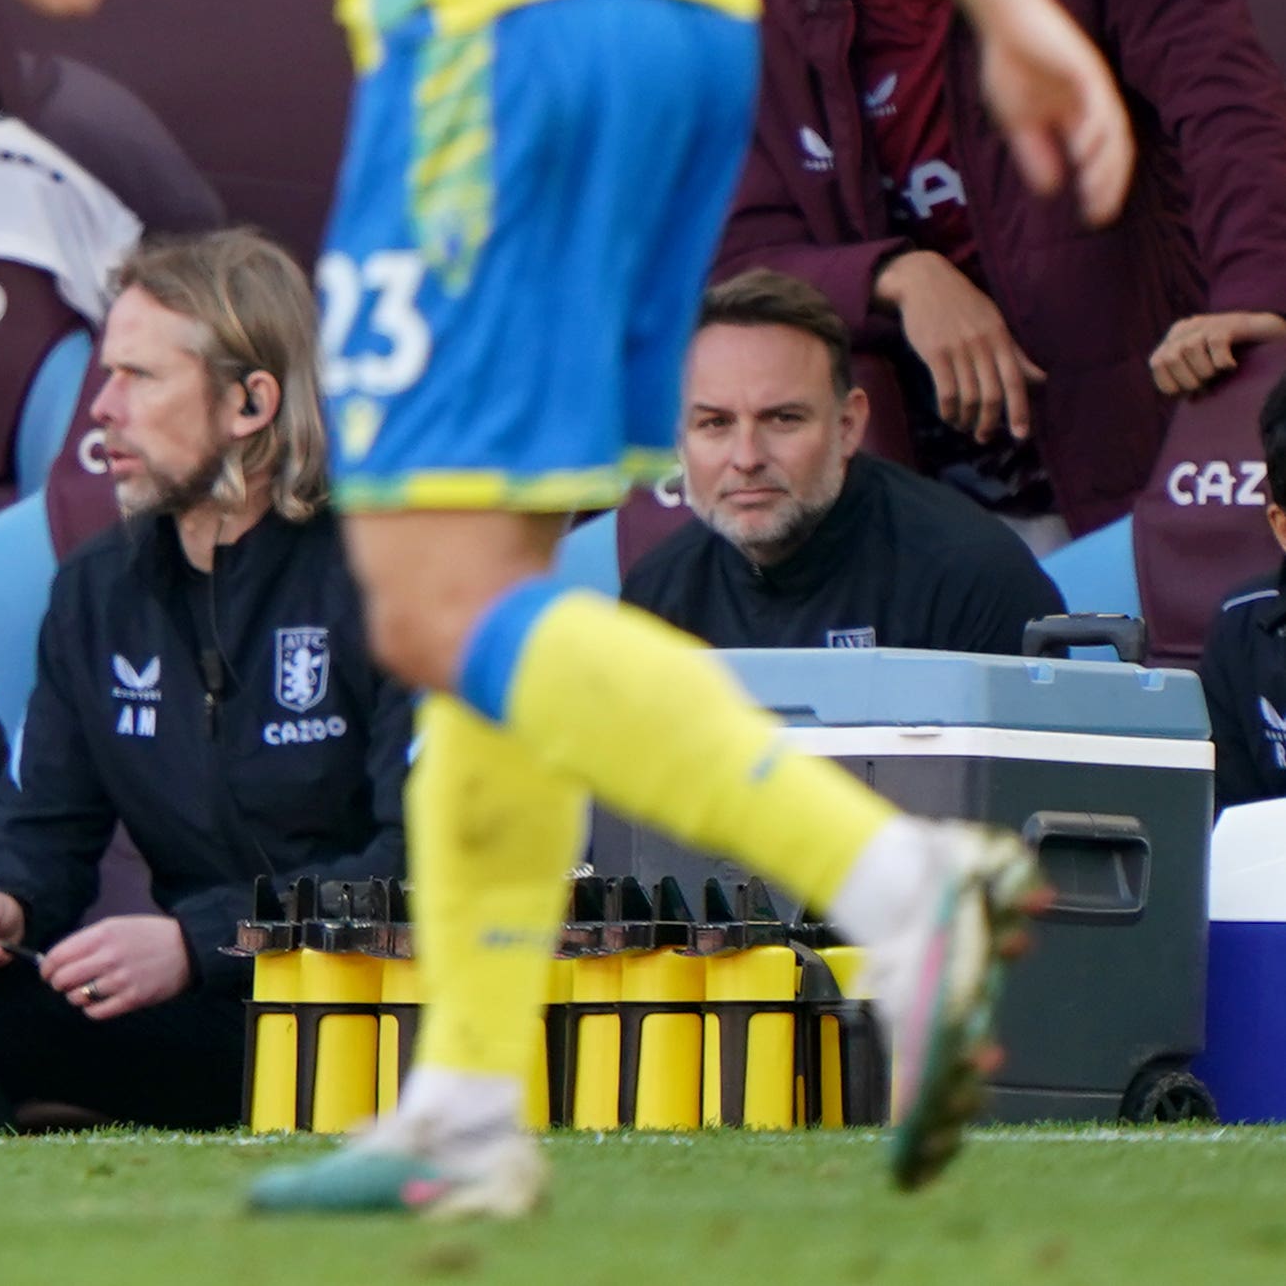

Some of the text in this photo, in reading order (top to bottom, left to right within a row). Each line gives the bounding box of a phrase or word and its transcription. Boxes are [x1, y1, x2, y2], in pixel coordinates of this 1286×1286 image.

[315, 250, 431, 397] 23
[1167, 460, 1268, 506] CAZ
[116, 704, 157, 738] AM
[263, 715, 348, 746] CAZOO
